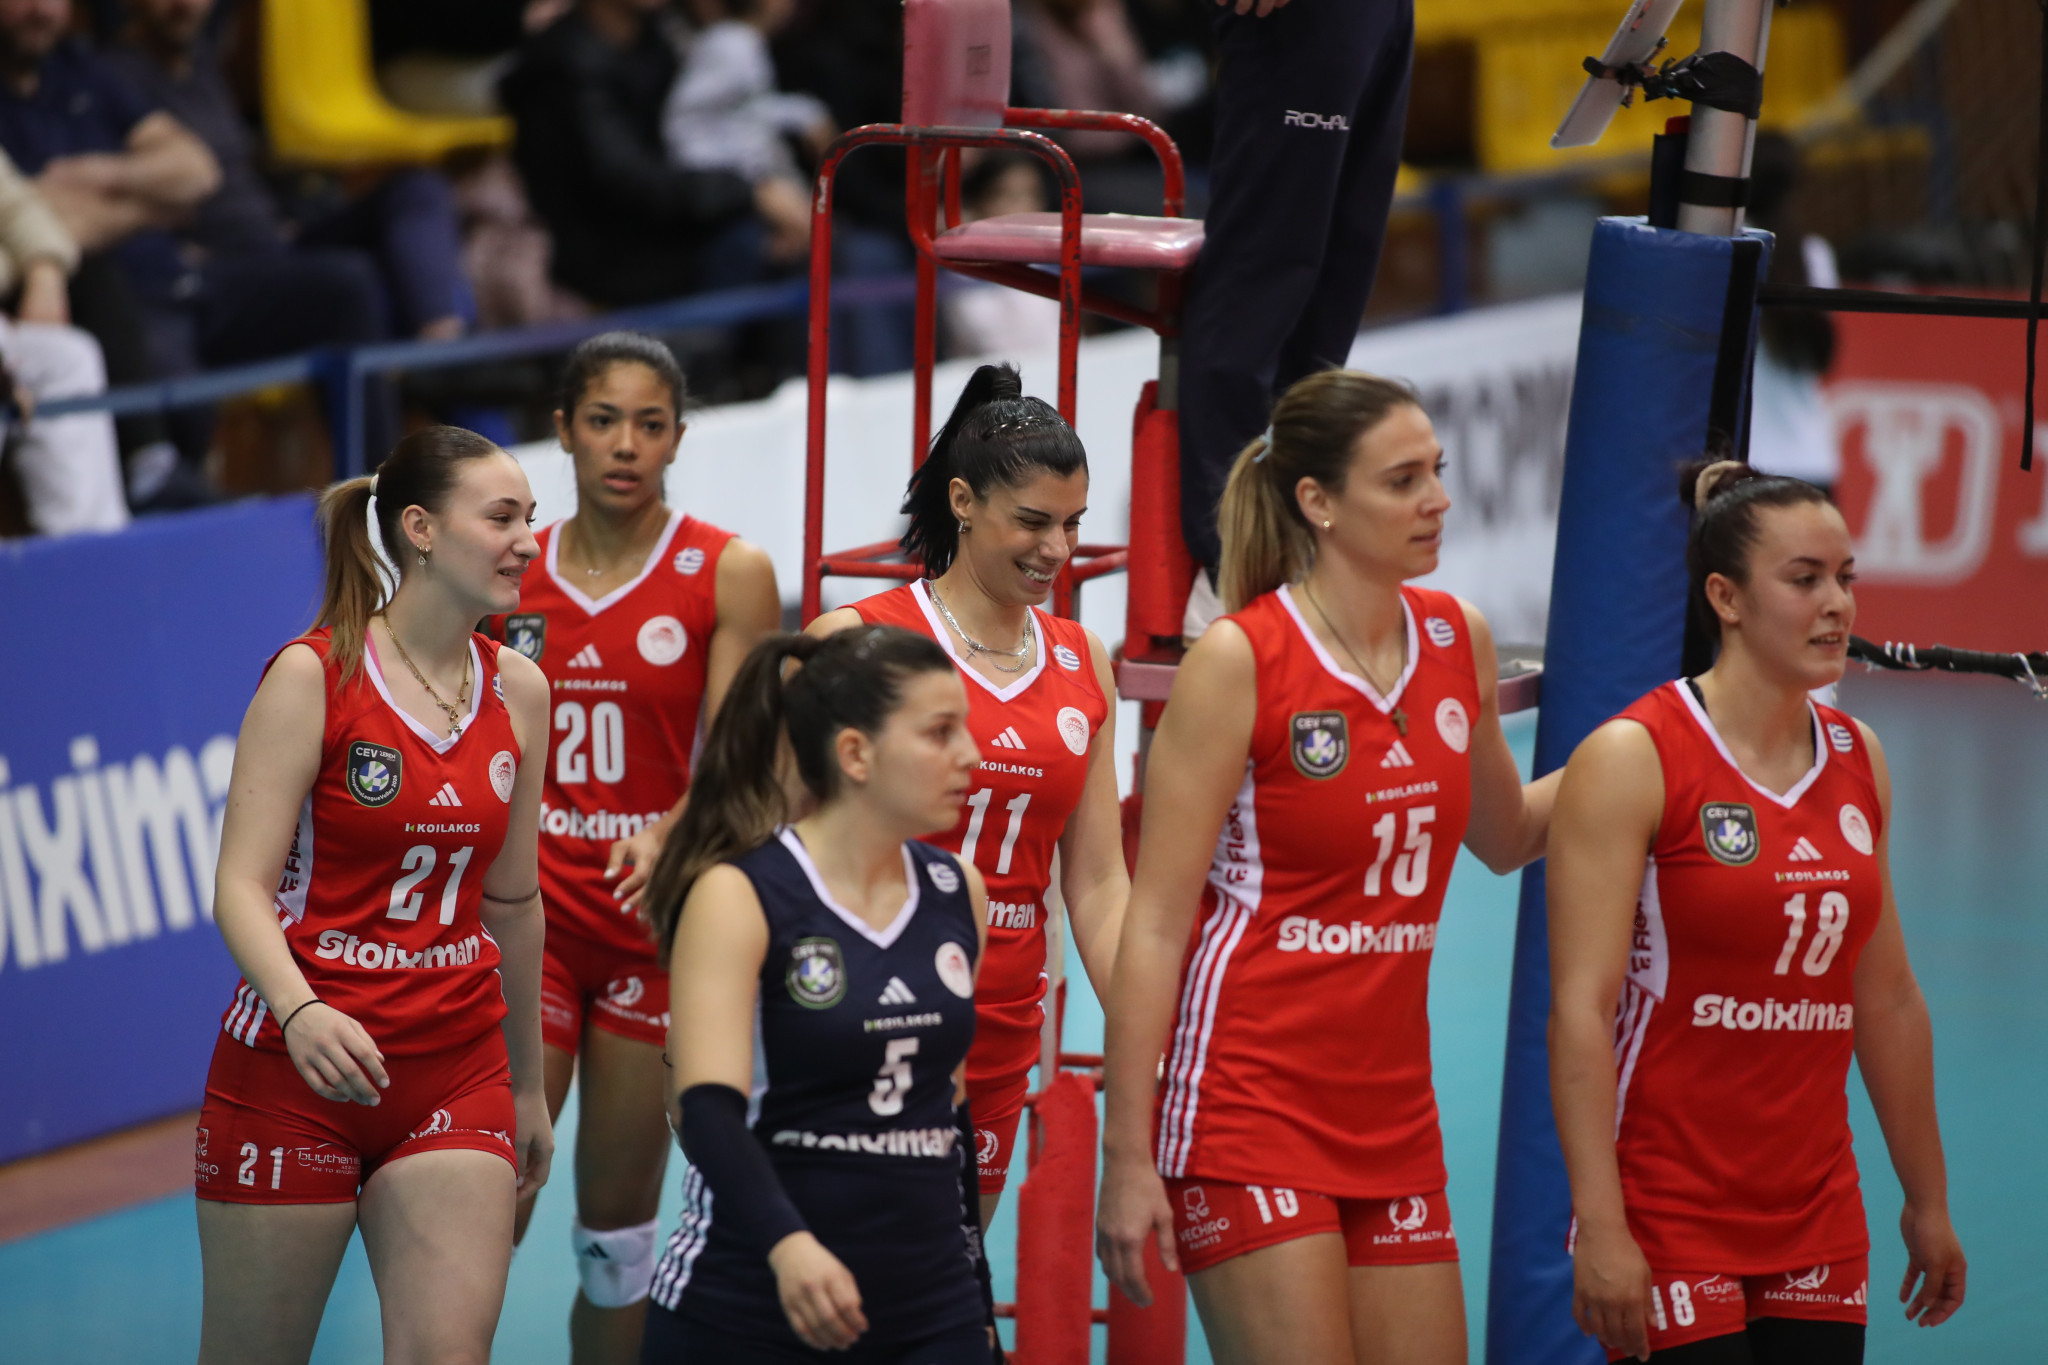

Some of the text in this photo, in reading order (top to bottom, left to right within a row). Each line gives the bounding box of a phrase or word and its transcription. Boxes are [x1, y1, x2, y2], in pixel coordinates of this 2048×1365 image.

[1284, 109, 1350, 130] ROYAL
[356, 747, 378, 758] CEV
[554, 701, 625, 784] 20
[979, 760, 1043, 778] KOILAKOS
[1377, 781, 1439, 801] KOILAKOS
[416, 823, 481, 833] KOILAKOS
[961, 788, 1031, 874] 11
[1364, 805, 1436, 896] 15
[385, 844, 475, 926] 21
[1785, 870, 1850, 882] KOILAKOS
[1774, 891, 1849, 977] 18
[868, 1037, 920, 1117] 5
[238, 1142, 284, 1190] 21
[1652, 1280, 1696, 1331] 18
